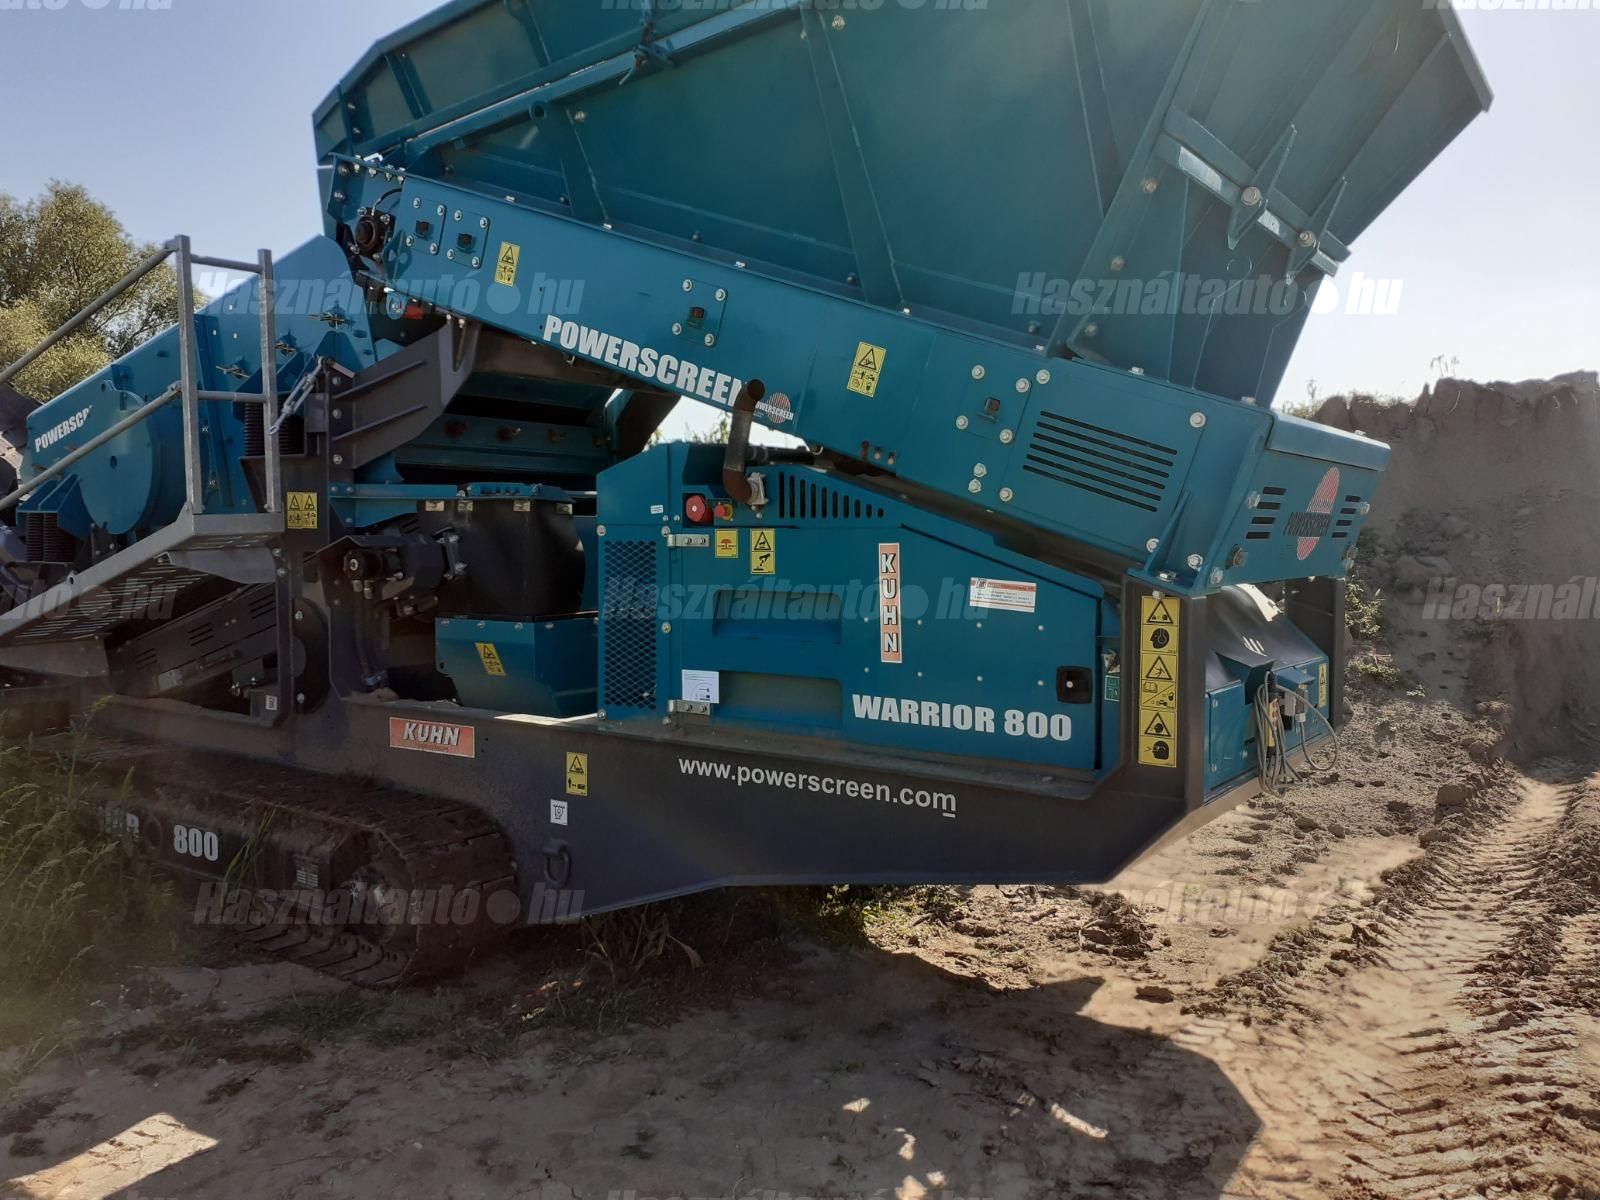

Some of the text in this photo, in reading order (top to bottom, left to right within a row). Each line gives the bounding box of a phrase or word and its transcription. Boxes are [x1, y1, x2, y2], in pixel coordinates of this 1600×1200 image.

[755, 400, 794, 421] OWERSCREEN
[881, 553, 898, 652] KUHN
[403, 722, 460, 746] KUHN
[852, 694, 1072, 741] WARRIOR 800
[678, 758, 957, 817] www.powerscreen.com
[173, 823, 218, 862] 800
